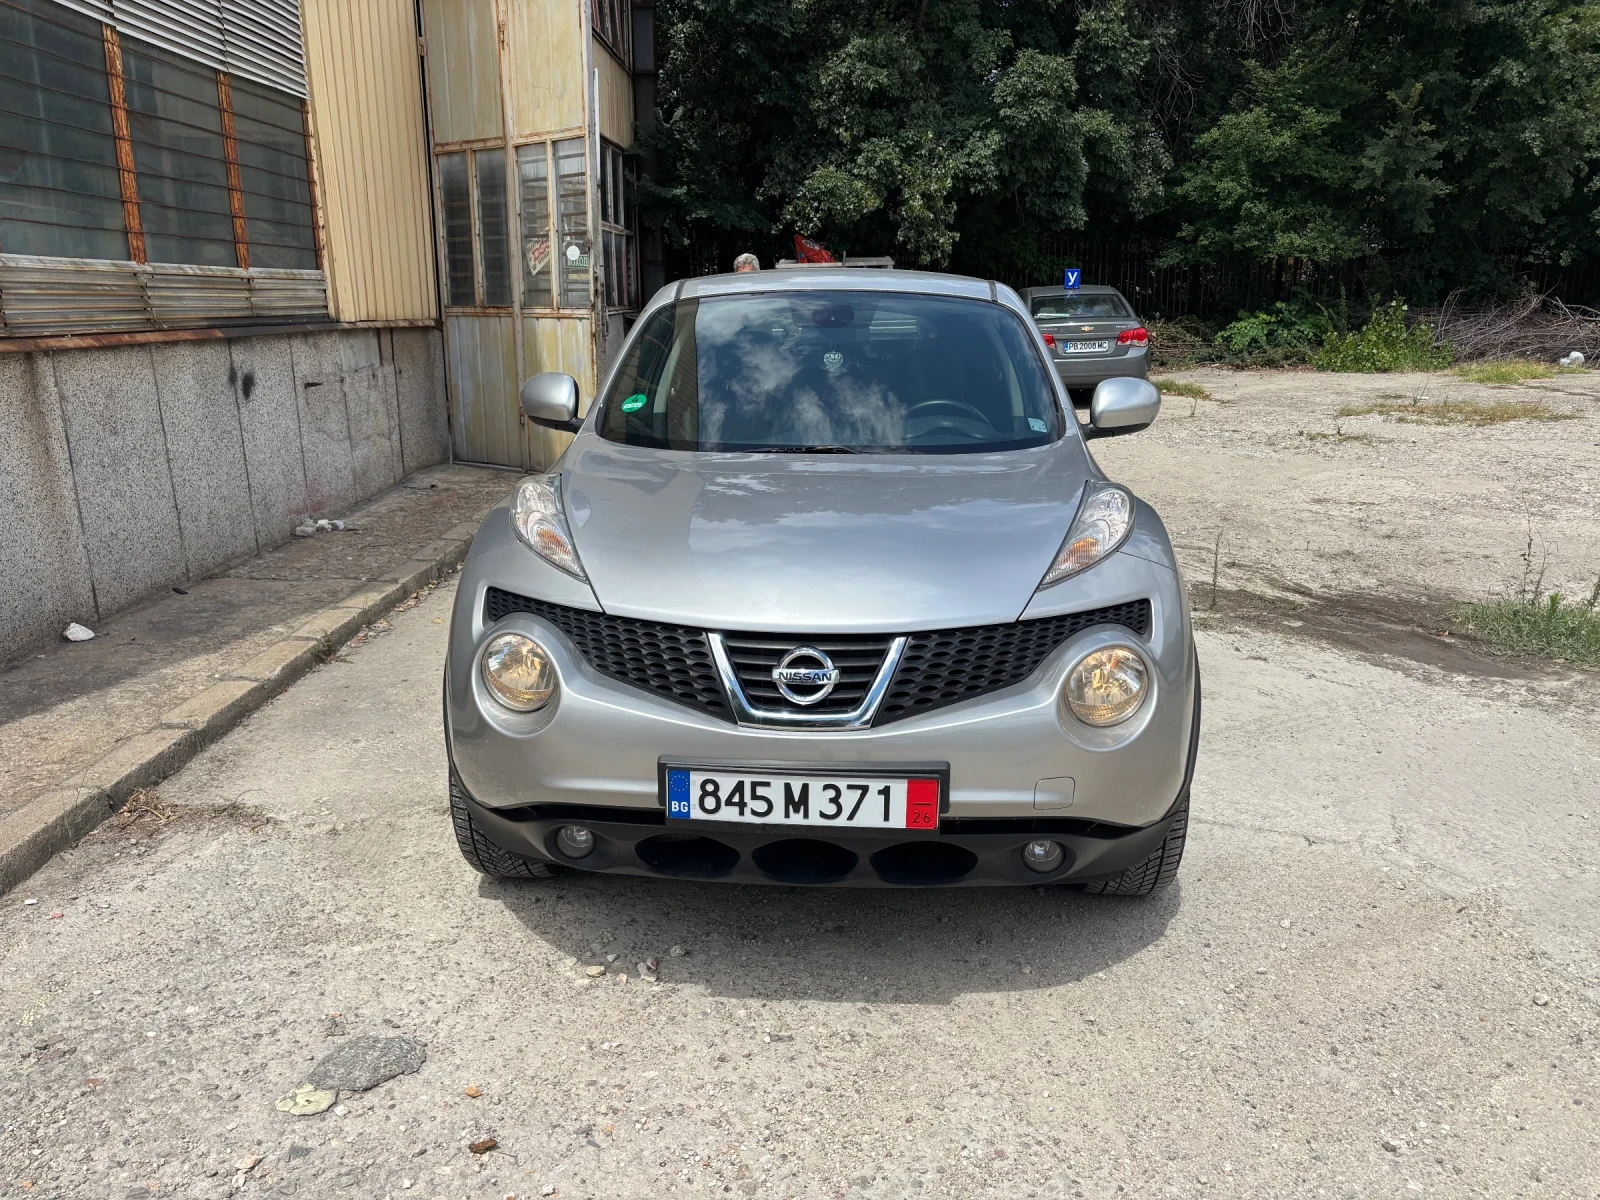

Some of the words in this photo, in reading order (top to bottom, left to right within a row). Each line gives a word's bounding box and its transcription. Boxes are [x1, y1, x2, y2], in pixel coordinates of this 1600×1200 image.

[778, 671, 832, 682] NISSAN
[671, 801, 688, 813] BG
[912, 811, 931, 824] 26
